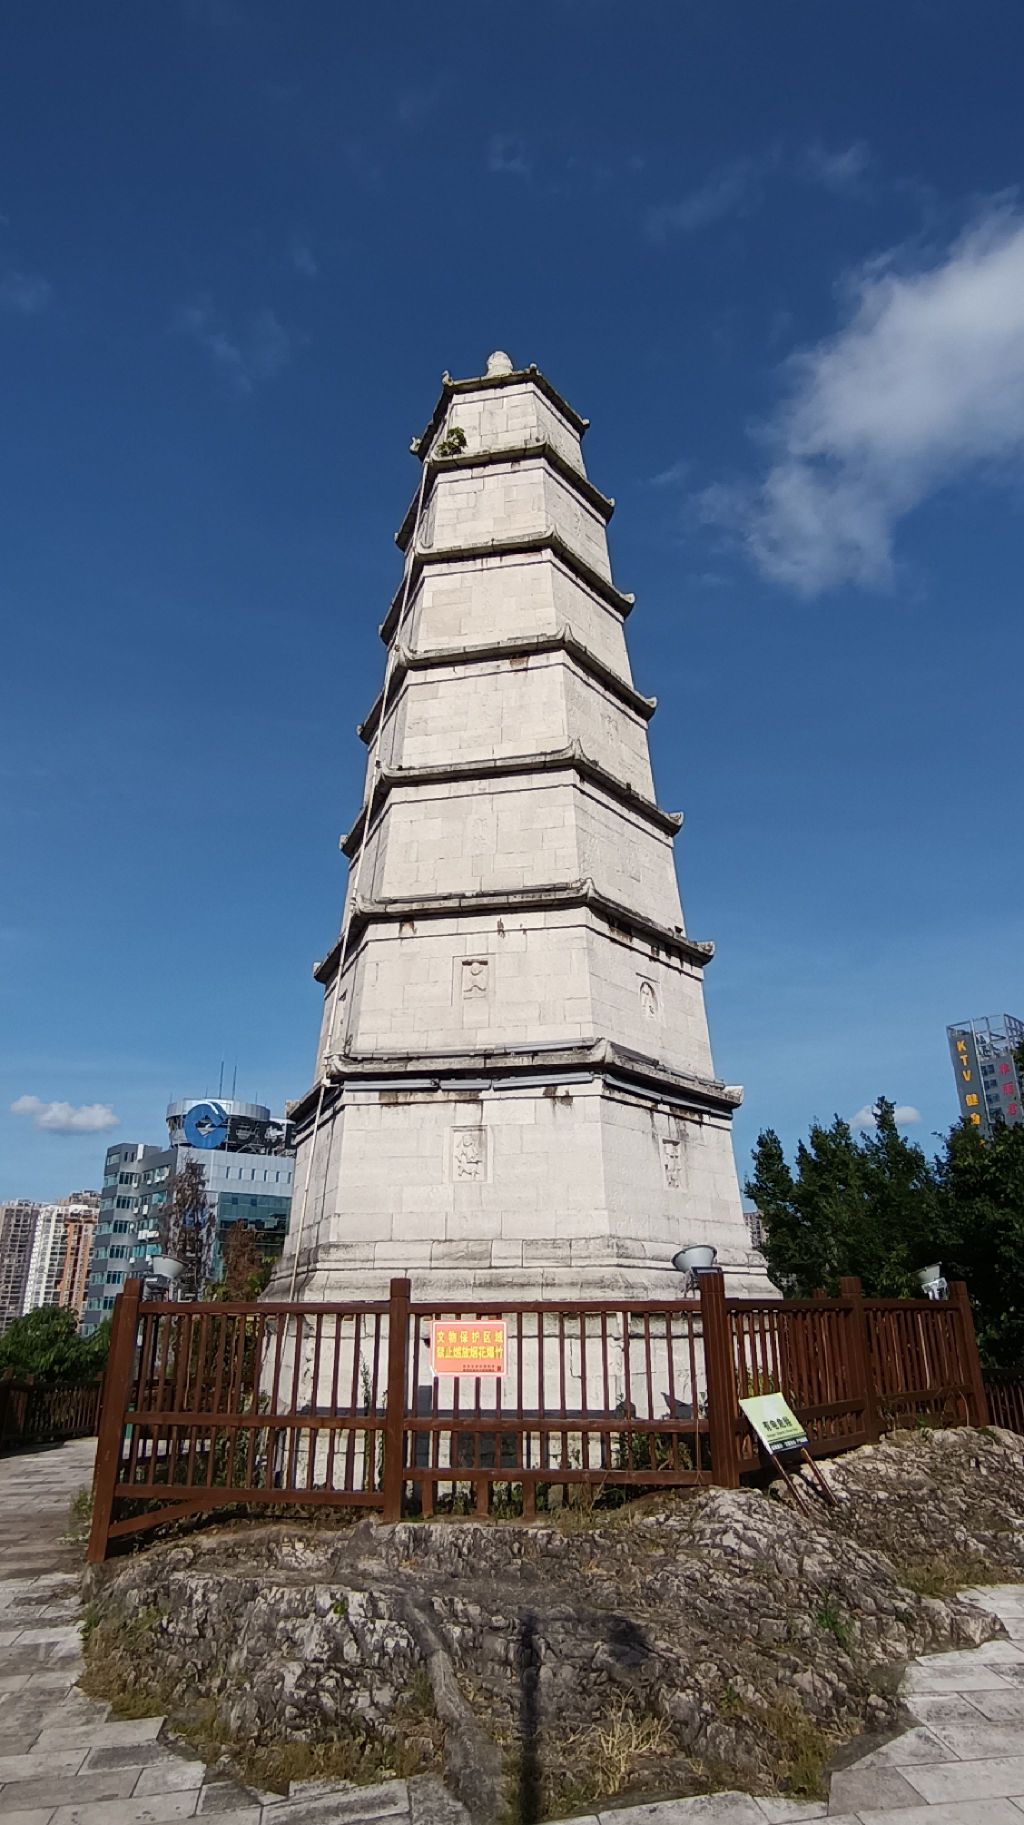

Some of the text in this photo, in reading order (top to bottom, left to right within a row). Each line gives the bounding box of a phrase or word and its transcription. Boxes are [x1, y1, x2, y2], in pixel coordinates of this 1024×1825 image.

[956, 1040, 971, 1081] KTV
[437, 1330, 503, 1343] 文物保护区域
